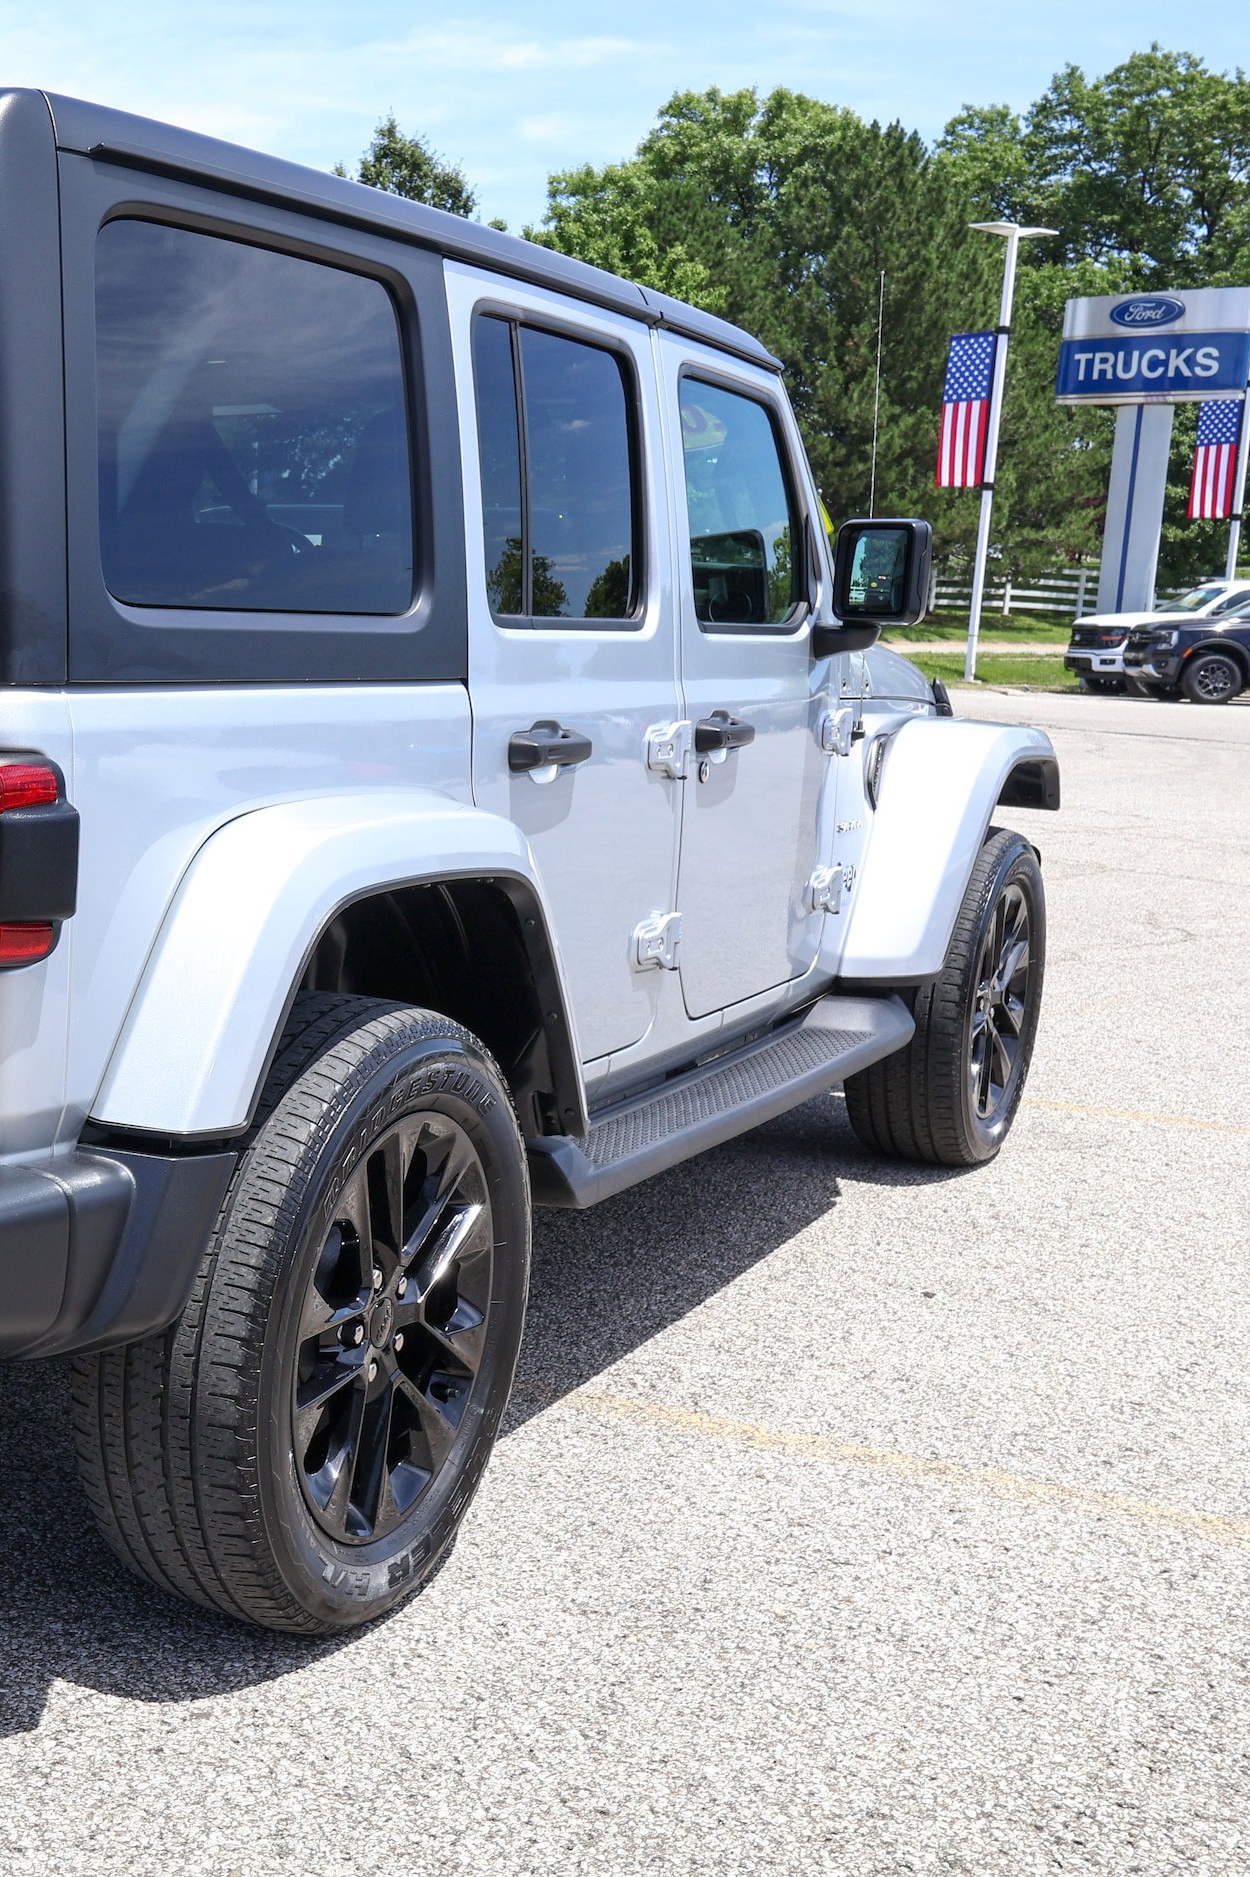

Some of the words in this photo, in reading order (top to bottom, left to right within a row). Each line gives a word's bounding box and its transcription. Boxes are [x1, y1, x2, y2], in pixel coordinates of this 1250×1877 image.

[1124, 302, 1166, 322] Ford
[1074, 346, 1220, 382] TRUCKS
[323, 1068, 498, 1224] BRIDGESTONE
